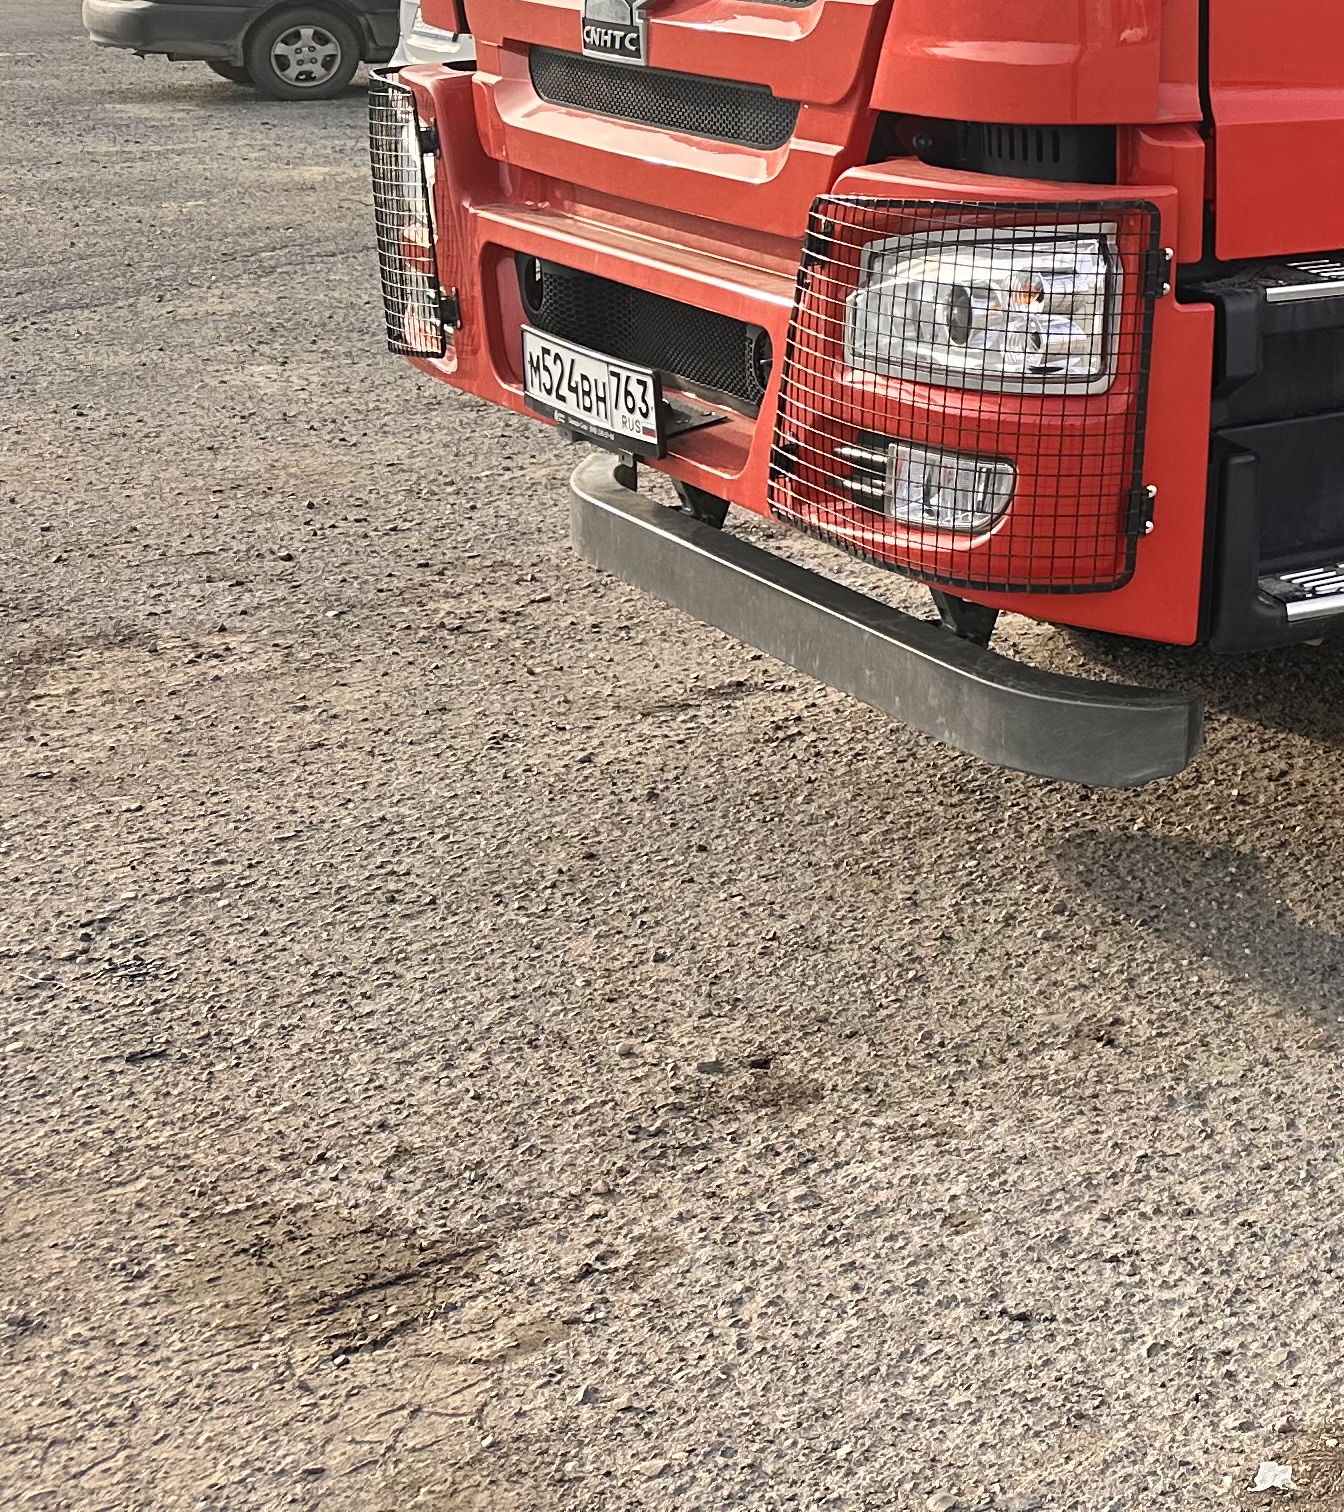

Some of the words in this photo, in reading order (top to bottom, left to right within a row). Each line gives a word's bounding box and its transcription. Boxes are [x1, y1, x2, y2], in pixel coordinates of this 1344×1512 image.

[583, 25, 640, 52] CNHTC
[609, 369, 650, 419] 763
[621, 414, 642, 434] RUS
